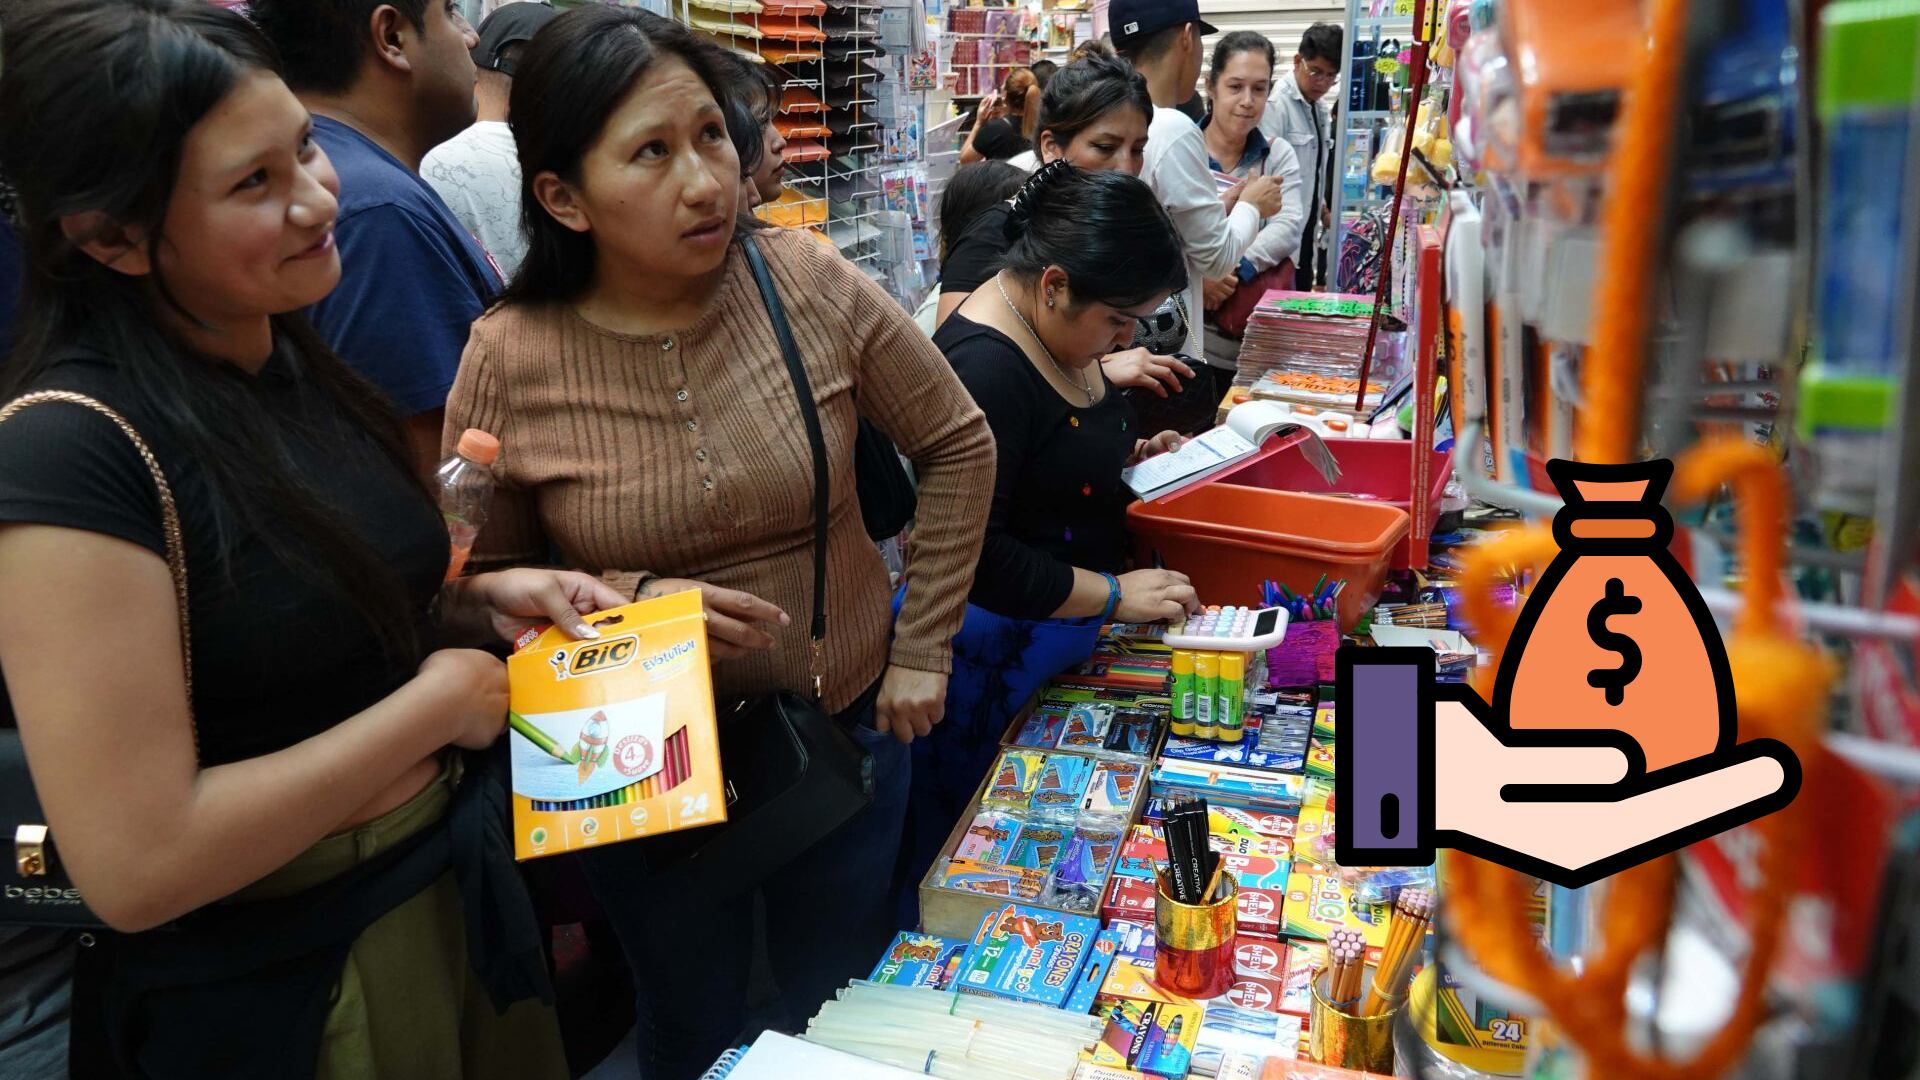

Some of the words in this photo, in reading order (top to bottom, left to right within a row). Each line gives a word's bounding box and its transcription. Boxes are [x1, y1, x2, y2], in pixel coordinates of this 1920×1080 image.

[680, 793, 709, 818] 24
[1238, 837, 1250, 855] DUO
[1173, 863, 1187, 900] CREATIVE
[1192, 857, 1202, 894] CREATIVE
[1247, 891, 1260, 917] SHELY
[987, 946, 1001, 960] 12
[1043, 932, 1085, 987] CRAYONES
[1249, 944, 1263, 970] SHELY
[881, 963, 900, 976] 10
[1242, 981, 1257, 1009] SHELY
[1130, 1011, 1153, 1056] CRAYONS
[1492, 1020, 1521, 1042] 24
